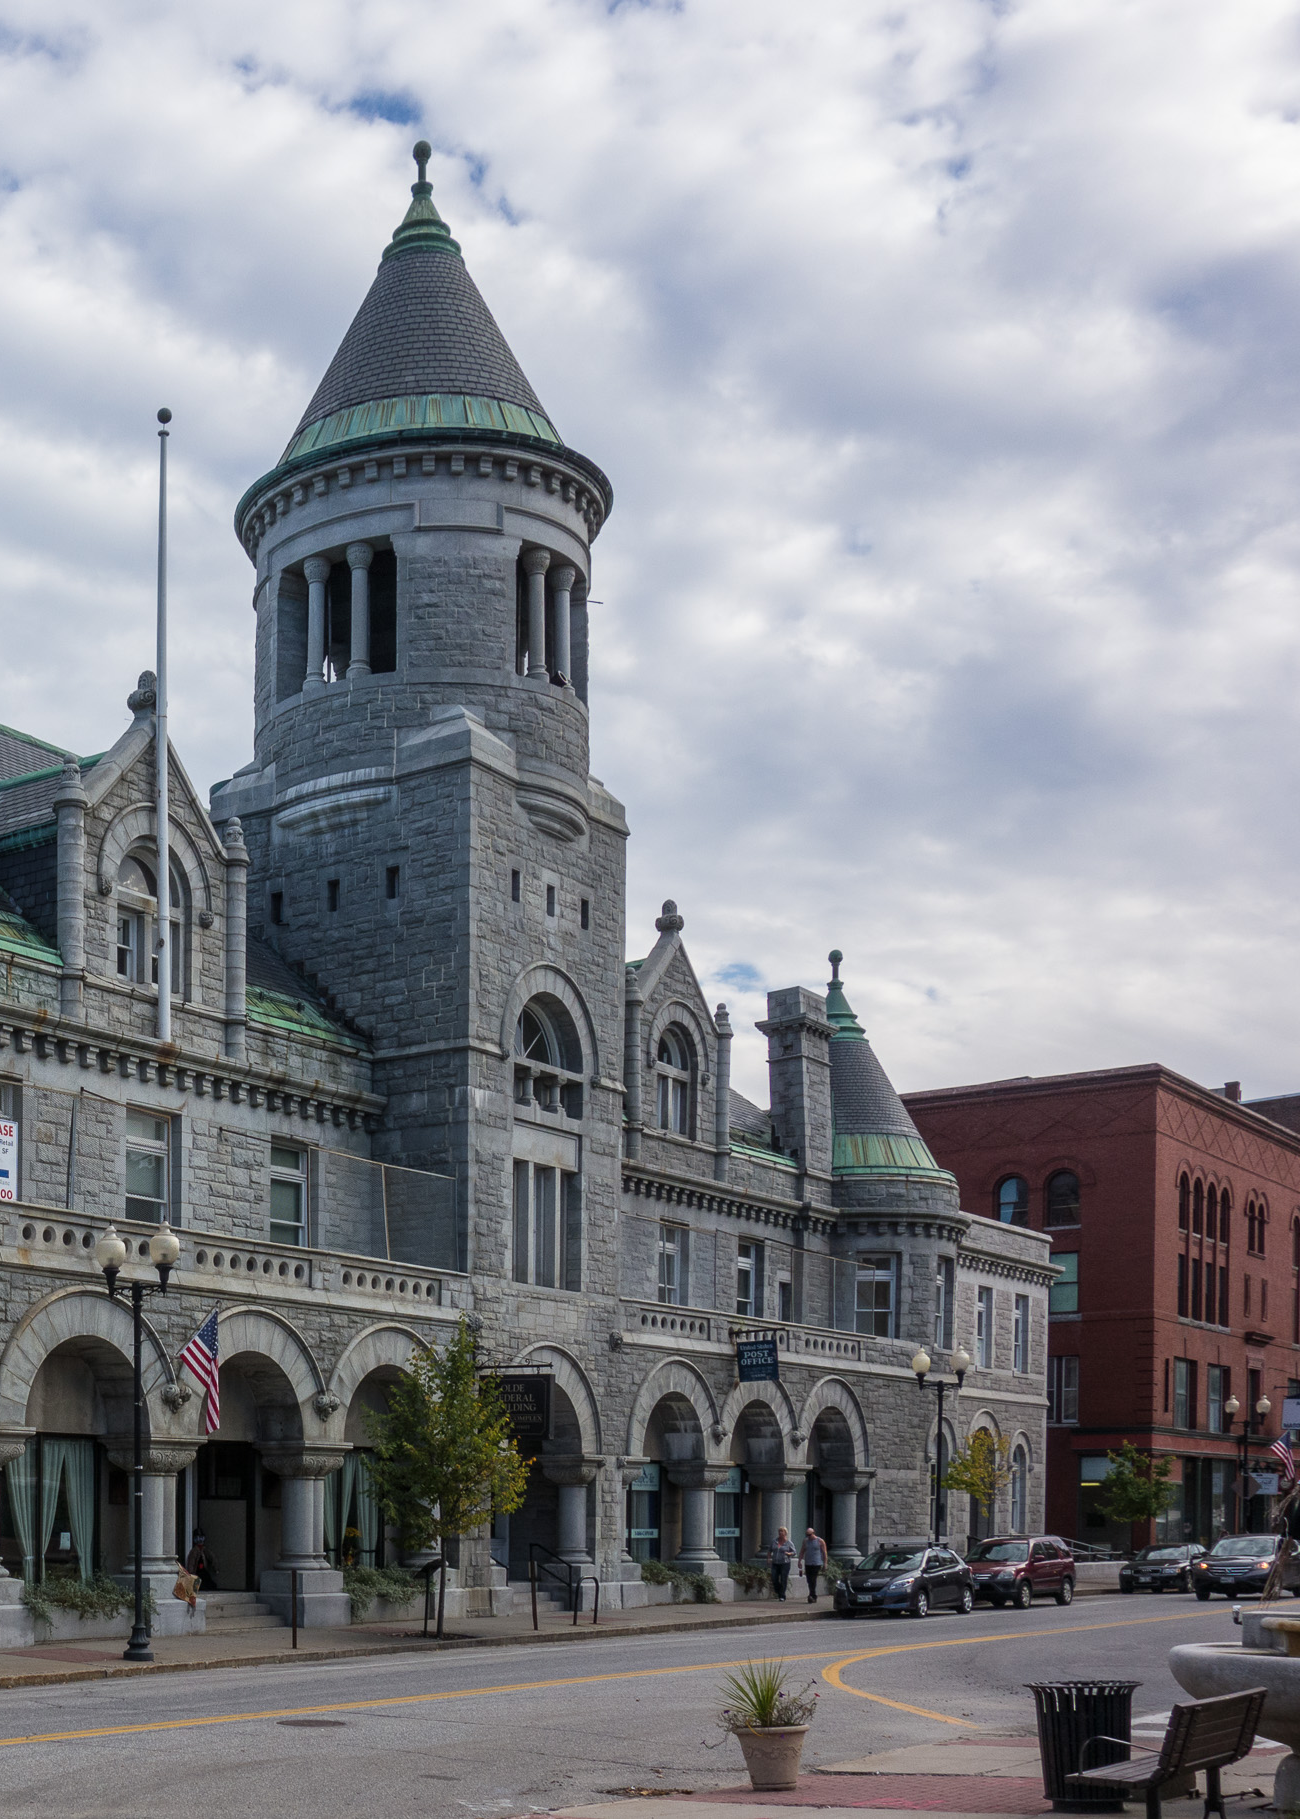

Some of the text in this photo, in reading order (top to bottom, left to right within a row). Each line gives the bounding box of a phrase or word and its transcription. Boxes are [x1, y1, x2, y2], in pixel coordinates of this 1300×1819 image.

[0, 1138, 13, 1146] Retail
[744, 1350, 768, 1358] POST
[741, 1356, 774, 1365] OFFICE
[501, 1384, 524, 1392] OLDE
